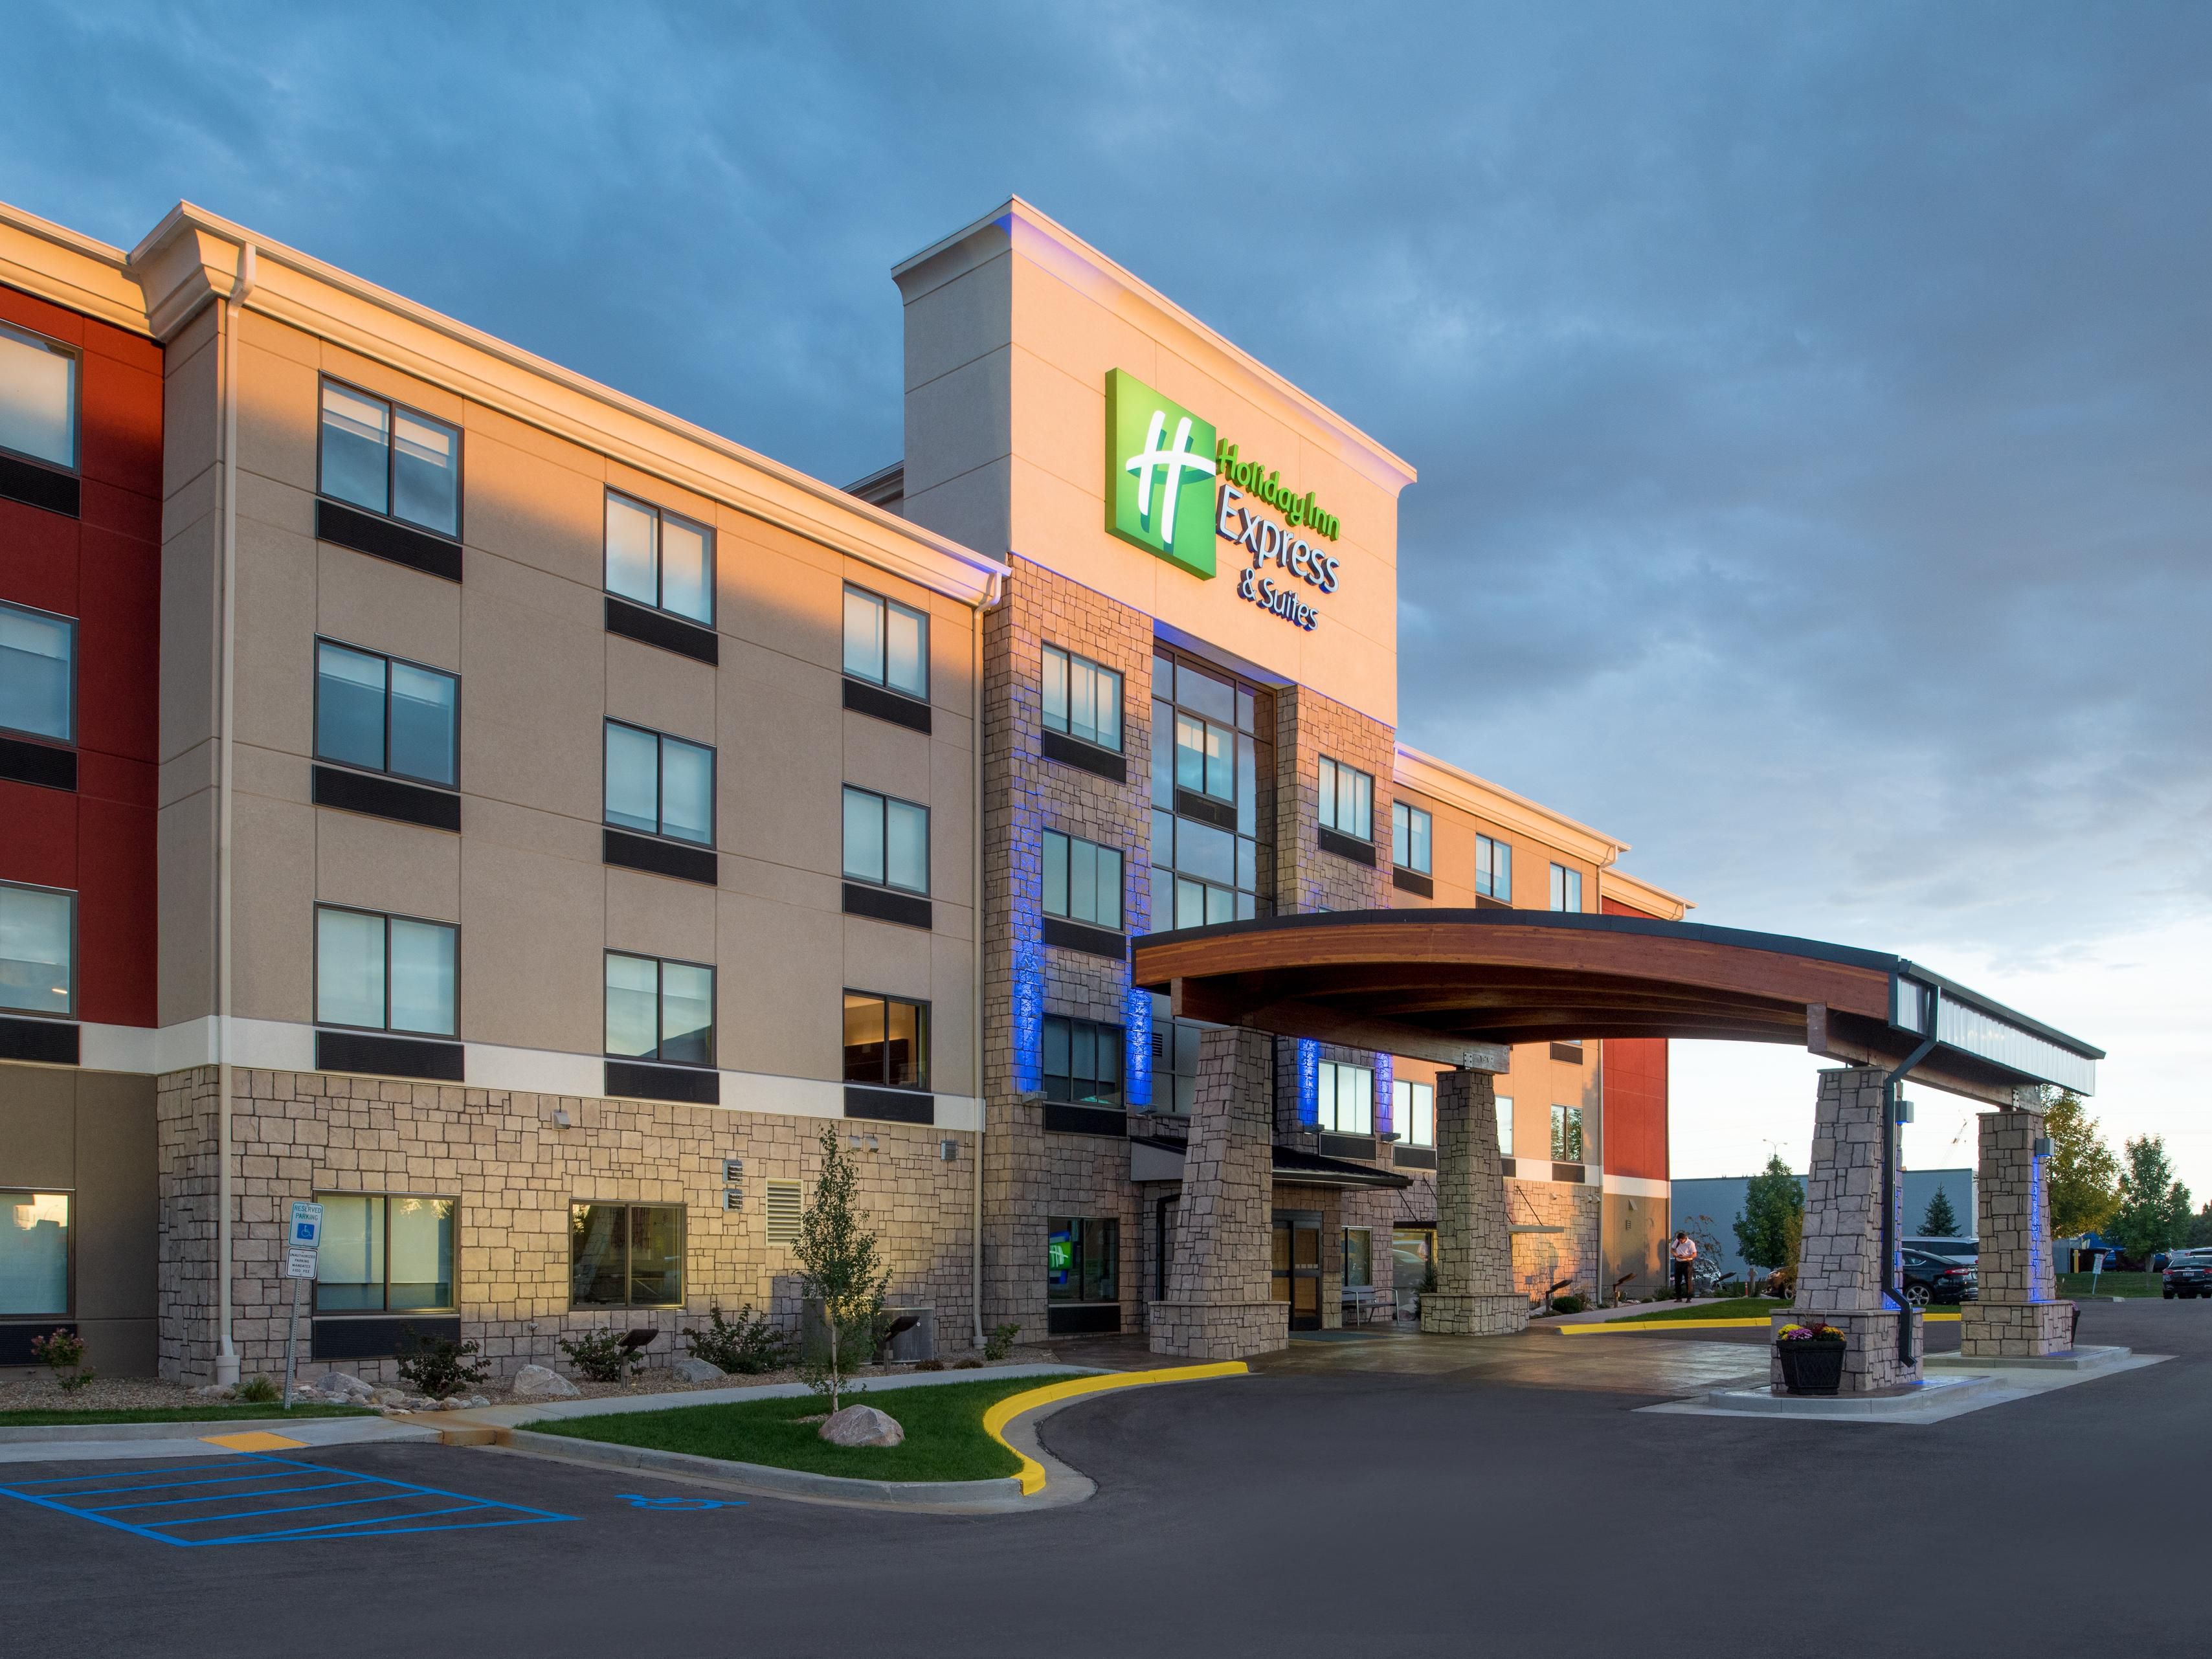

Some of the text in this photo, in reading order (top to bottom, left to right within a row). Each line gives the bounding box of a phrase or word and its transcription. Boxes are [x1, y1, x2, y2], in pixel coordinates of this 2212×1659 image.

[1216, 438, 1341, 542] Holiday Inn
[1216, 484, 1340, 594] Express
[1237, 567, 1319, 632] & Suites
[295, 1205, 322, 1214] RESERVED
